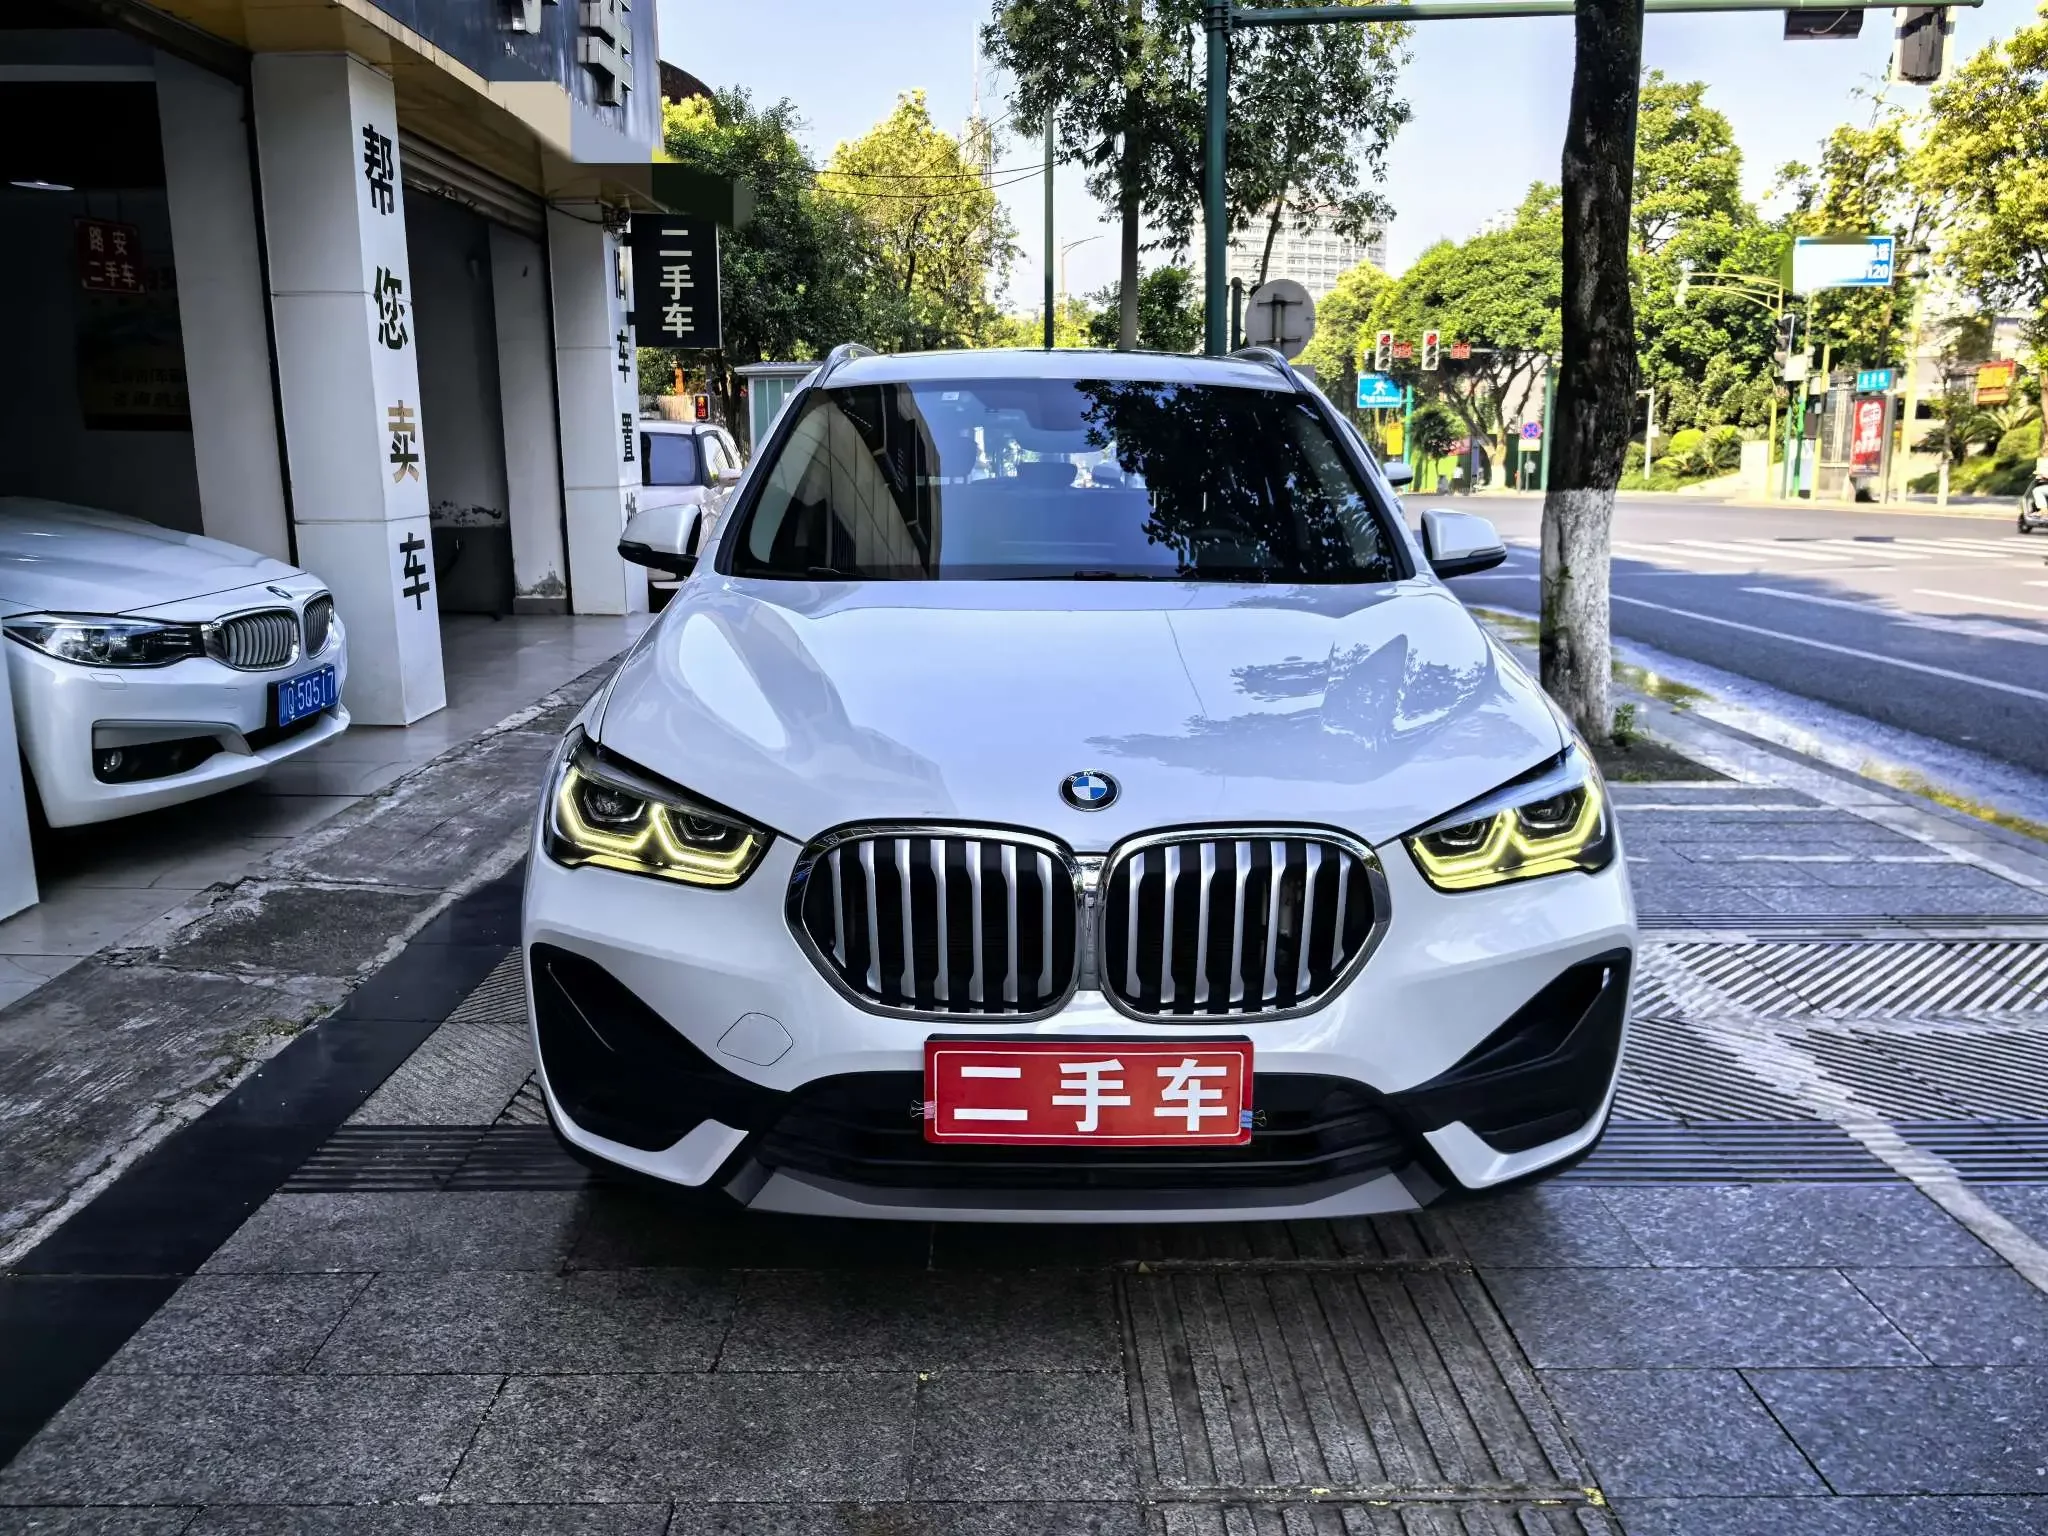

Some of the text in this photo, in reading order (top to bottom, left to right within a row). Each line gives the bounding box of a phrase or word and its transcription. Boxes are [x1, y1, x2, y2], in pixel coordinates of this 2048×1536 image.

[88, 260, 137, 288] 二手车
[659, 228, 695, 339] 二手车
[362, 123, 430, 611] 帮您卖车
[953, 1057, 1228, 1132] 二手车
